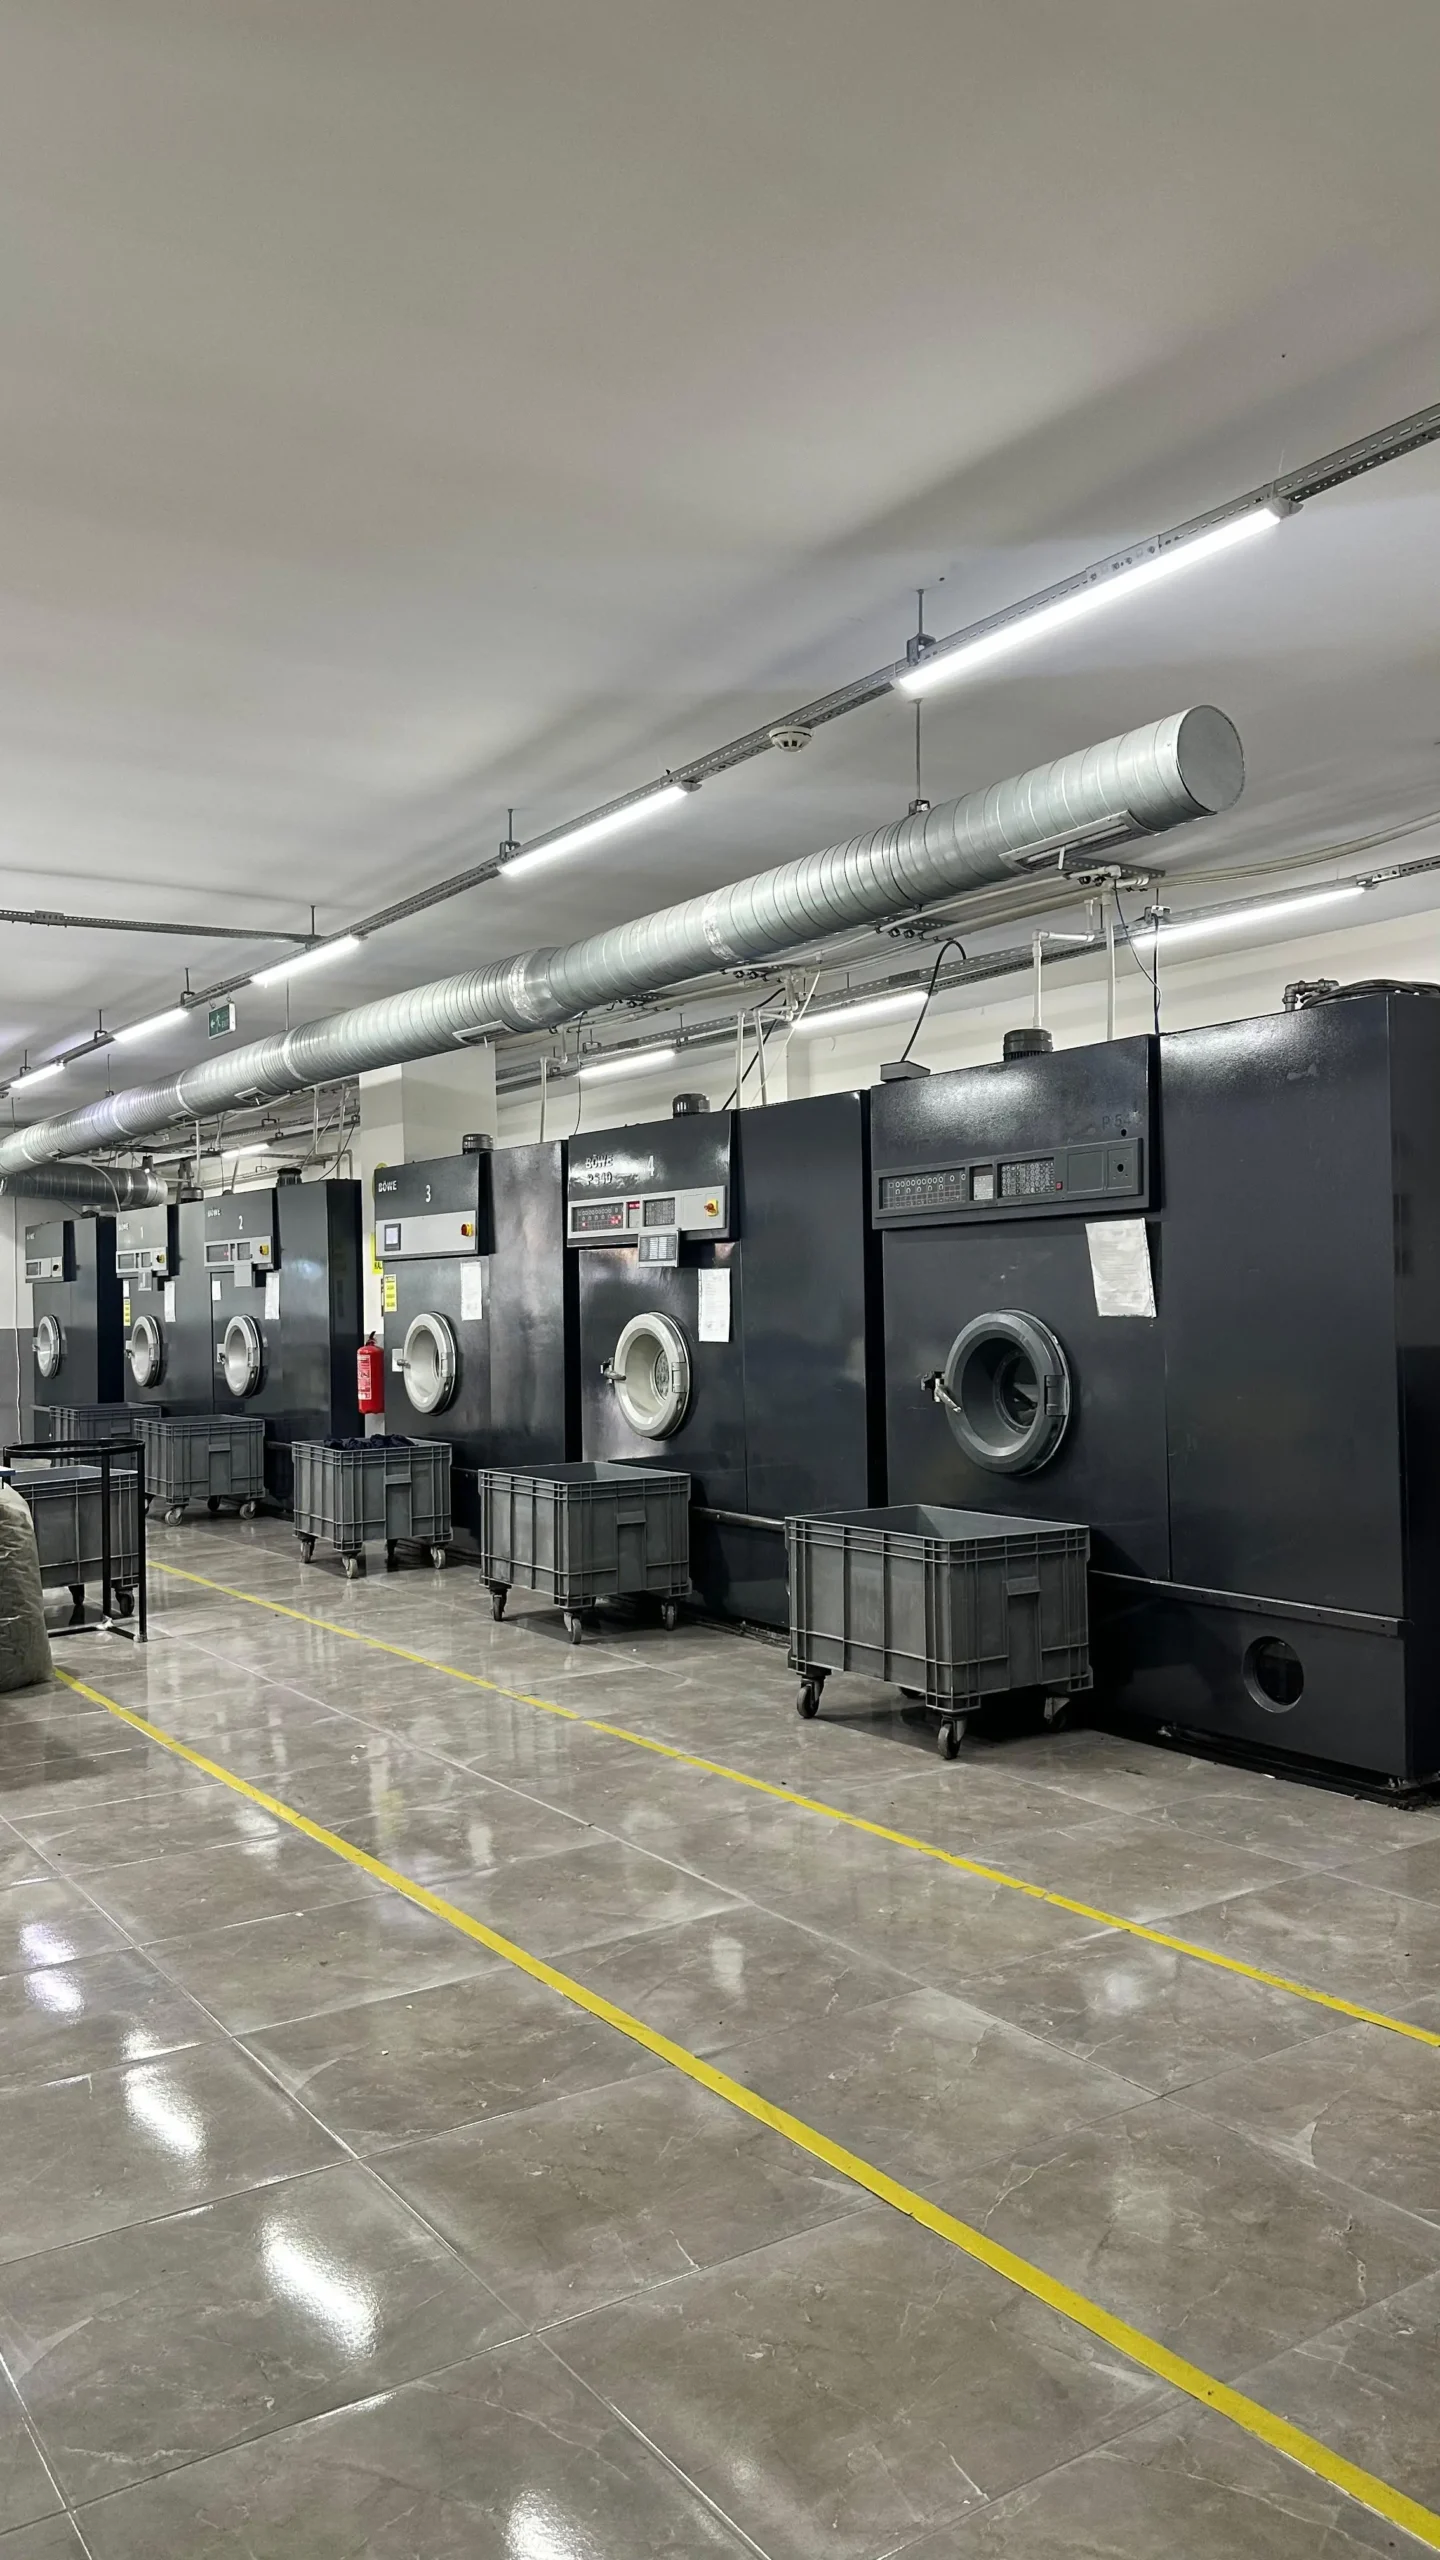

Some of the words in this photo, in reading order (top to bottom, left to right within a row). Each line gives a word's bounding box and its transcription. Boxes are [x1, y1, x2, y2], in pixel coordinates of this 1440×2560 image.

[585, 1153, 613, 1169] BÖWE
[647, 1155, 655, 1177] 4
[378, 1180, 397, 1193] BÖWE
[425, 1184, 431, 1203] 3
[238, 1215, 243, 1230] 2
